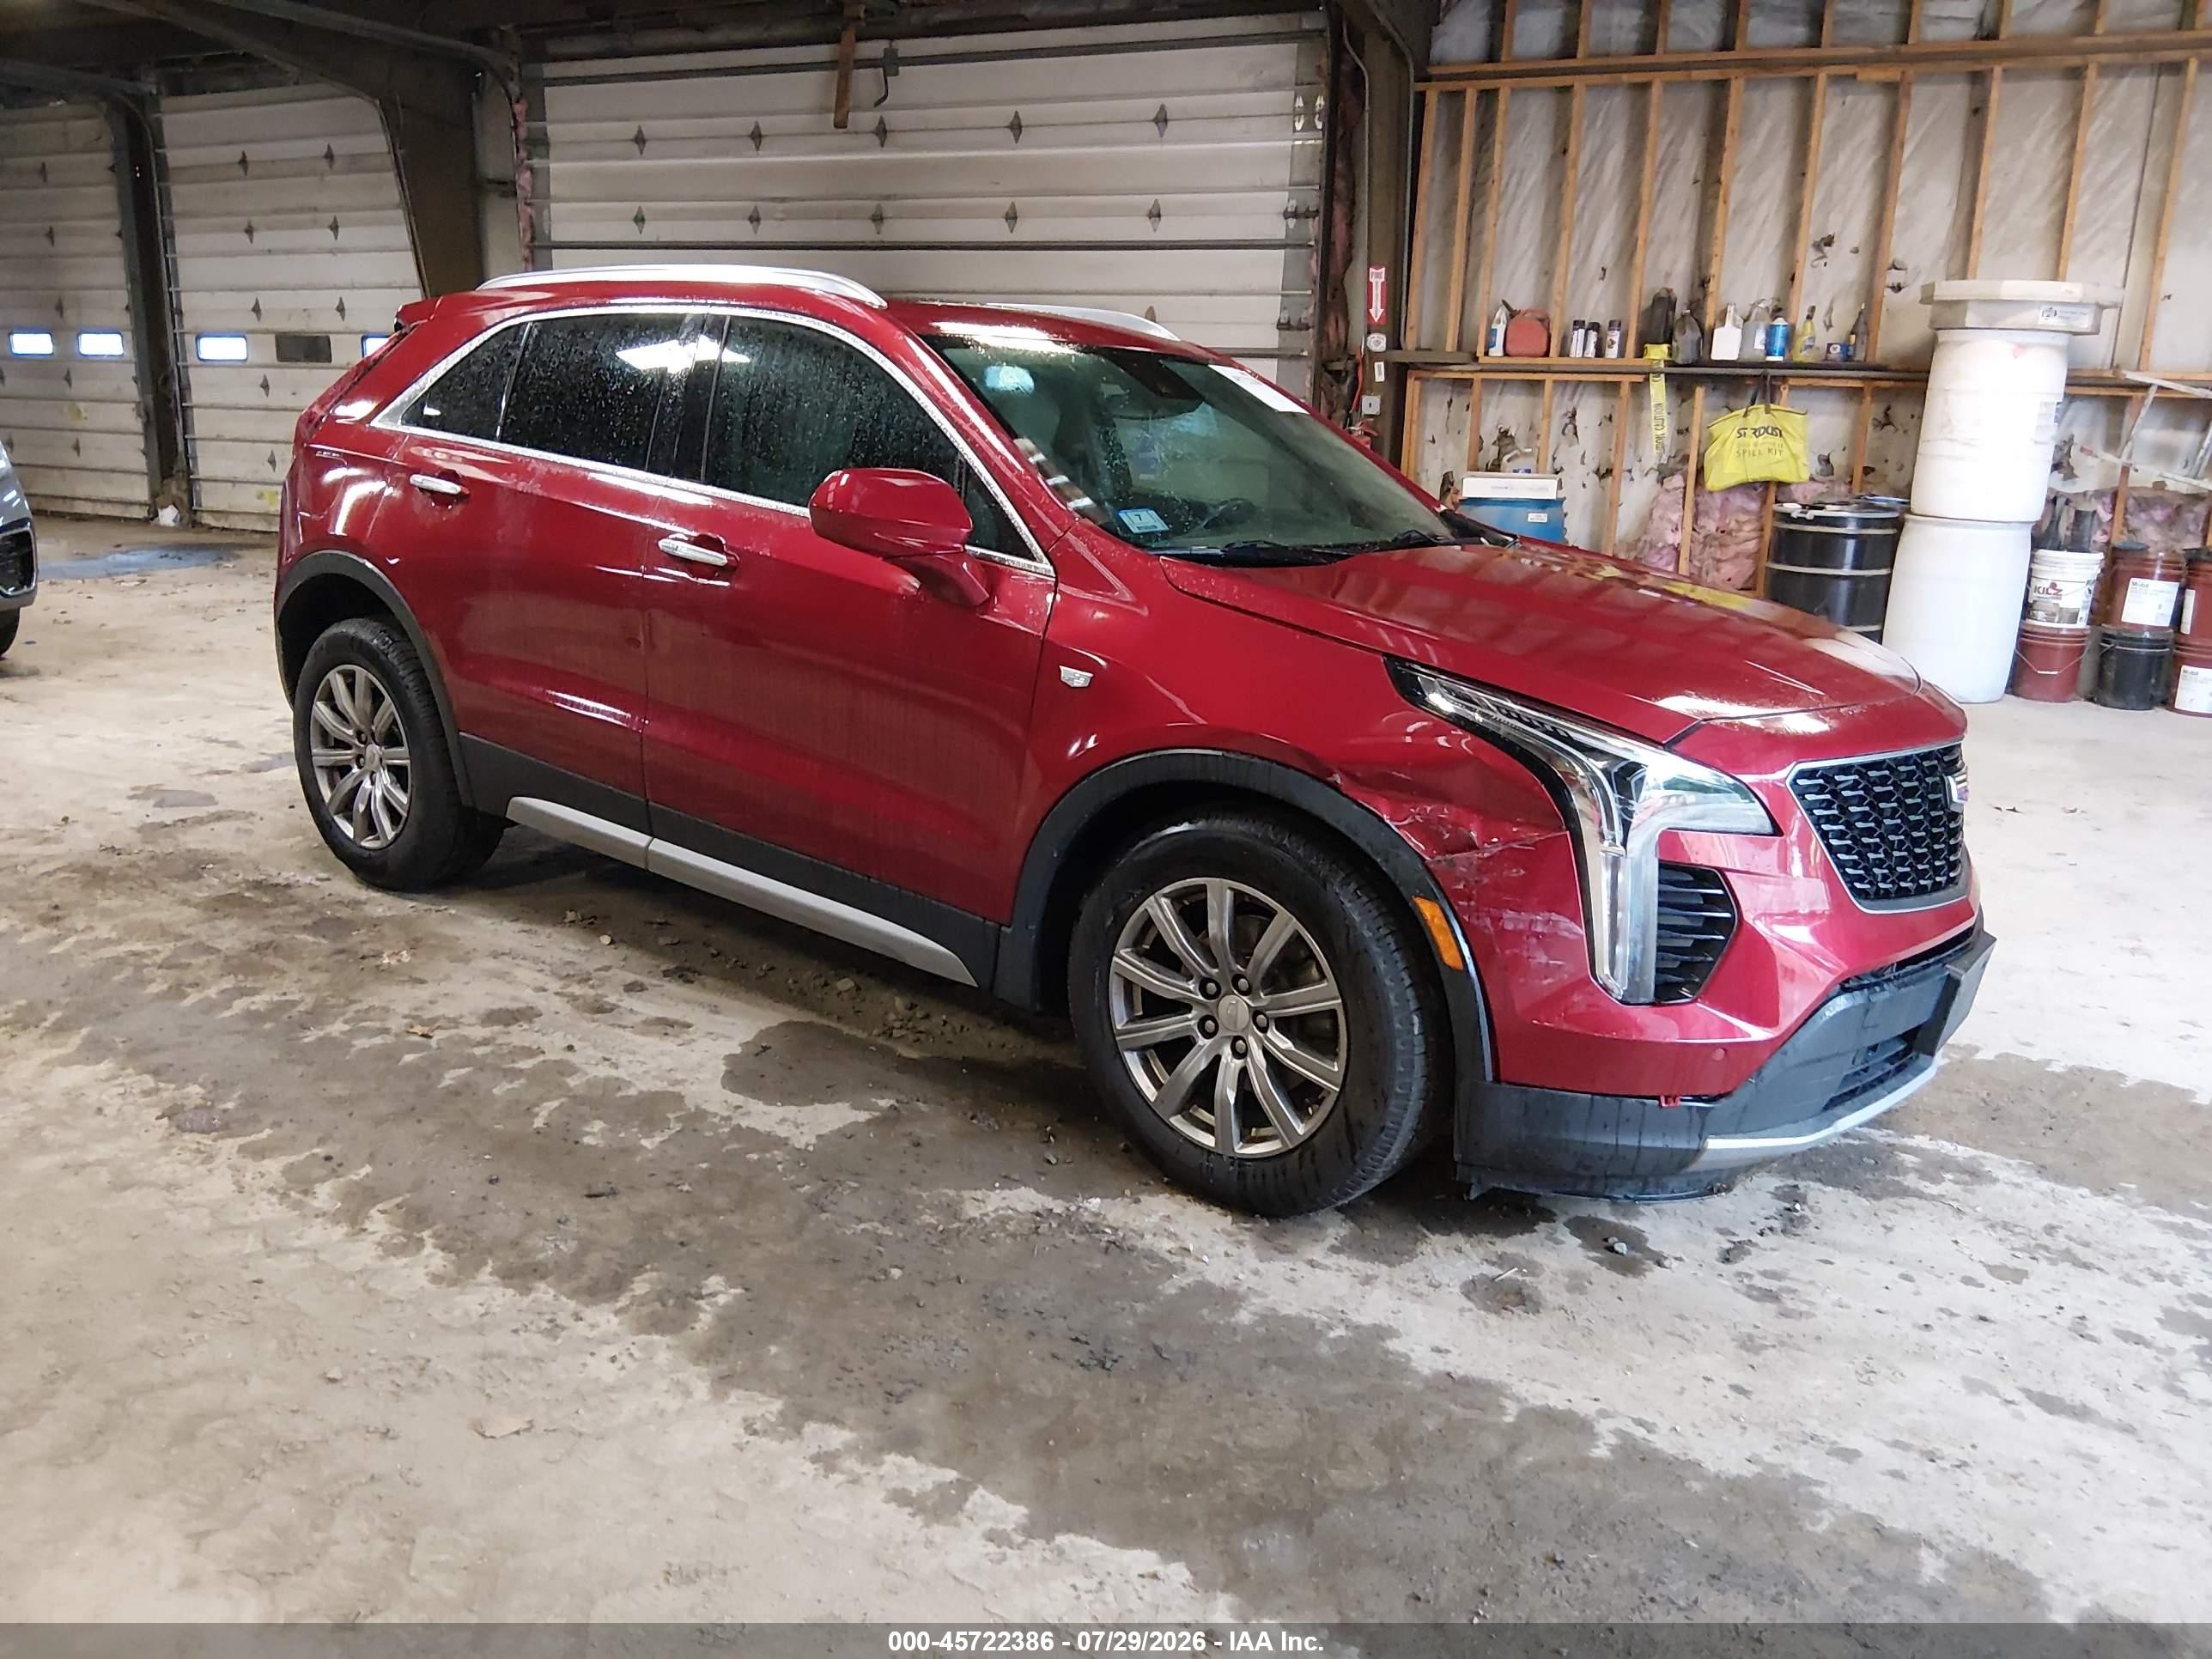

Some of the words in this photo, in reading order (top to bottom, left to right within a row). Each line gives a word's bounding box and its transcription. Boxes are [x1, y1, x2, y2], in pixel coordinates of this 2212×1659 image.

[1653, 403, 1665, 431] CAUTION
[1736, 426, 1783, 439] STRDUST
[1736, 447, 1763, 458] SPILL
[1768, 447, 1784, 457] KIT
[2033, 584, 2063, 597] KILZ
